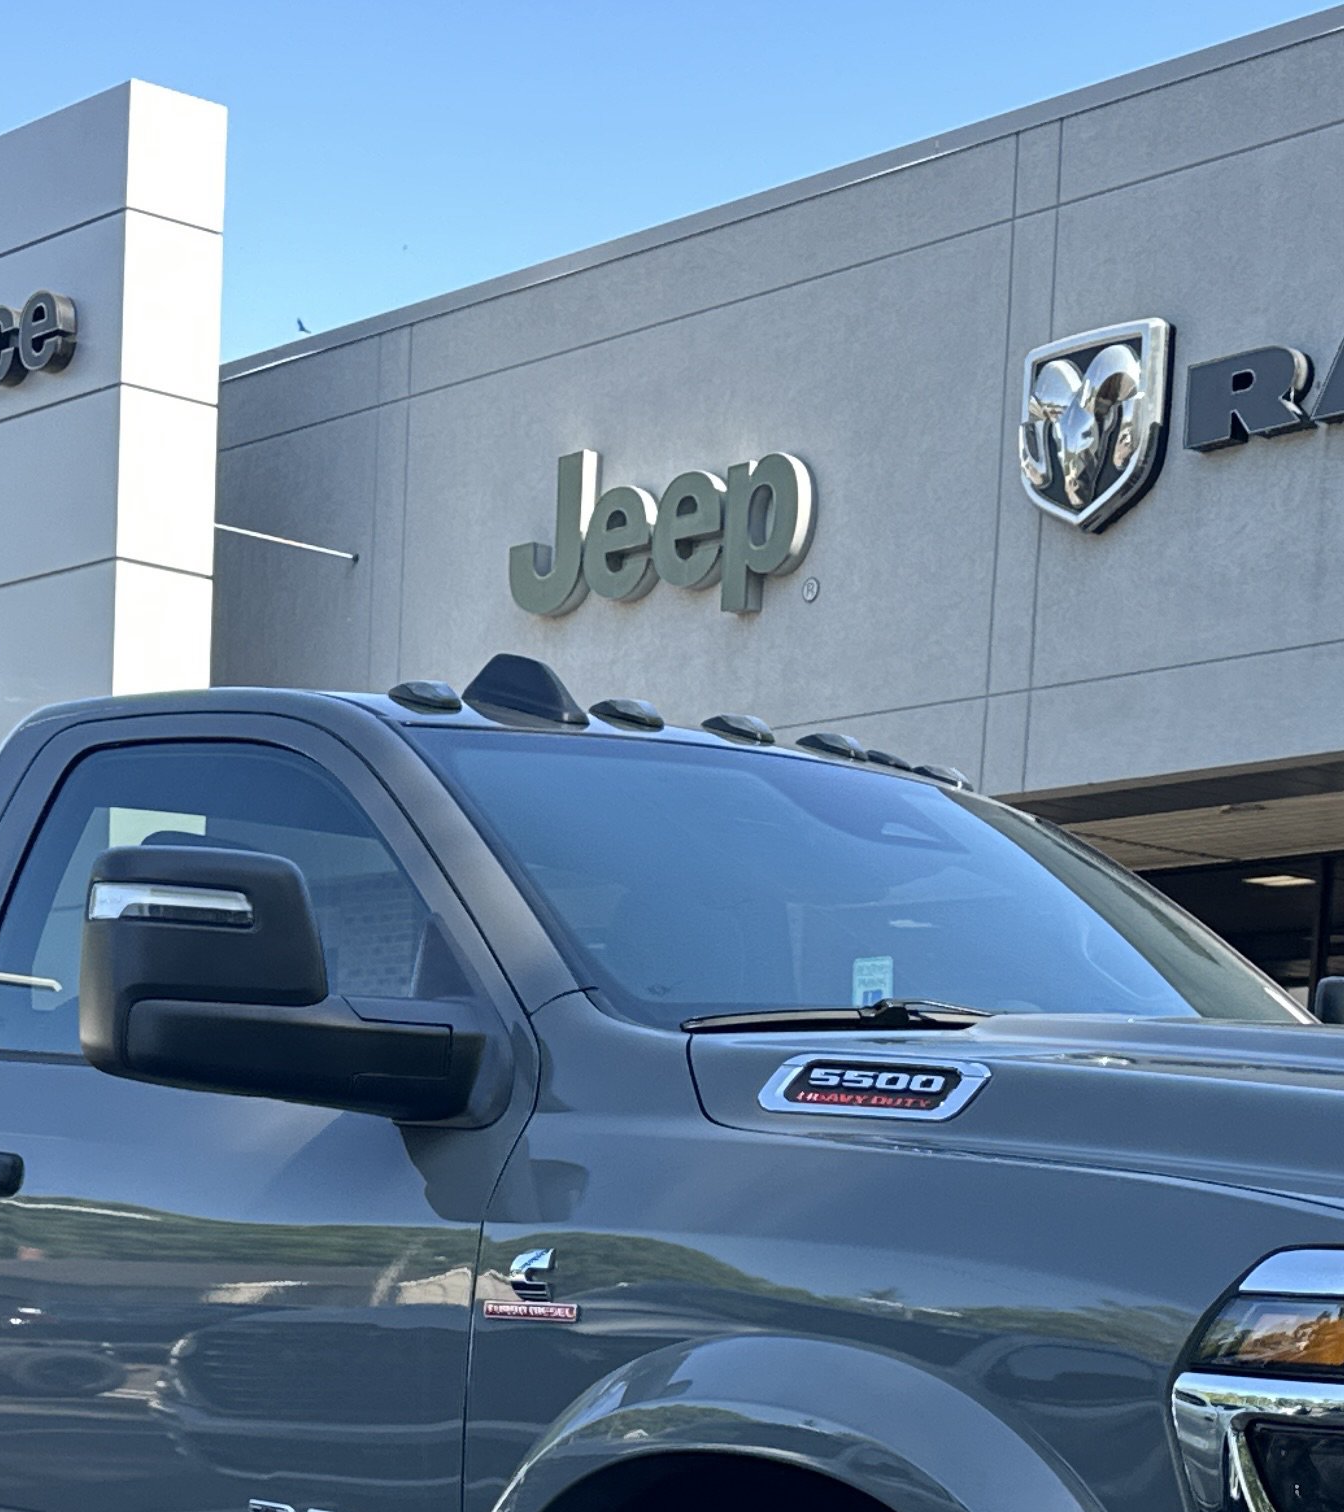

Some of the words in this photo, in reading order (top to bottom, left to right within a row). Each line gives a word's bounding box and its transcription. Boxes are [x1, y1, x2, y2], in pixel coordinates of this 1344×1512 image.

[509, 448, 818, 616] Jeep
[808, 1067, 945, 1093] 5500
[797, 1091, 869, 1104] HEAVY
[871, 1095, 931, 1108] DUTY
